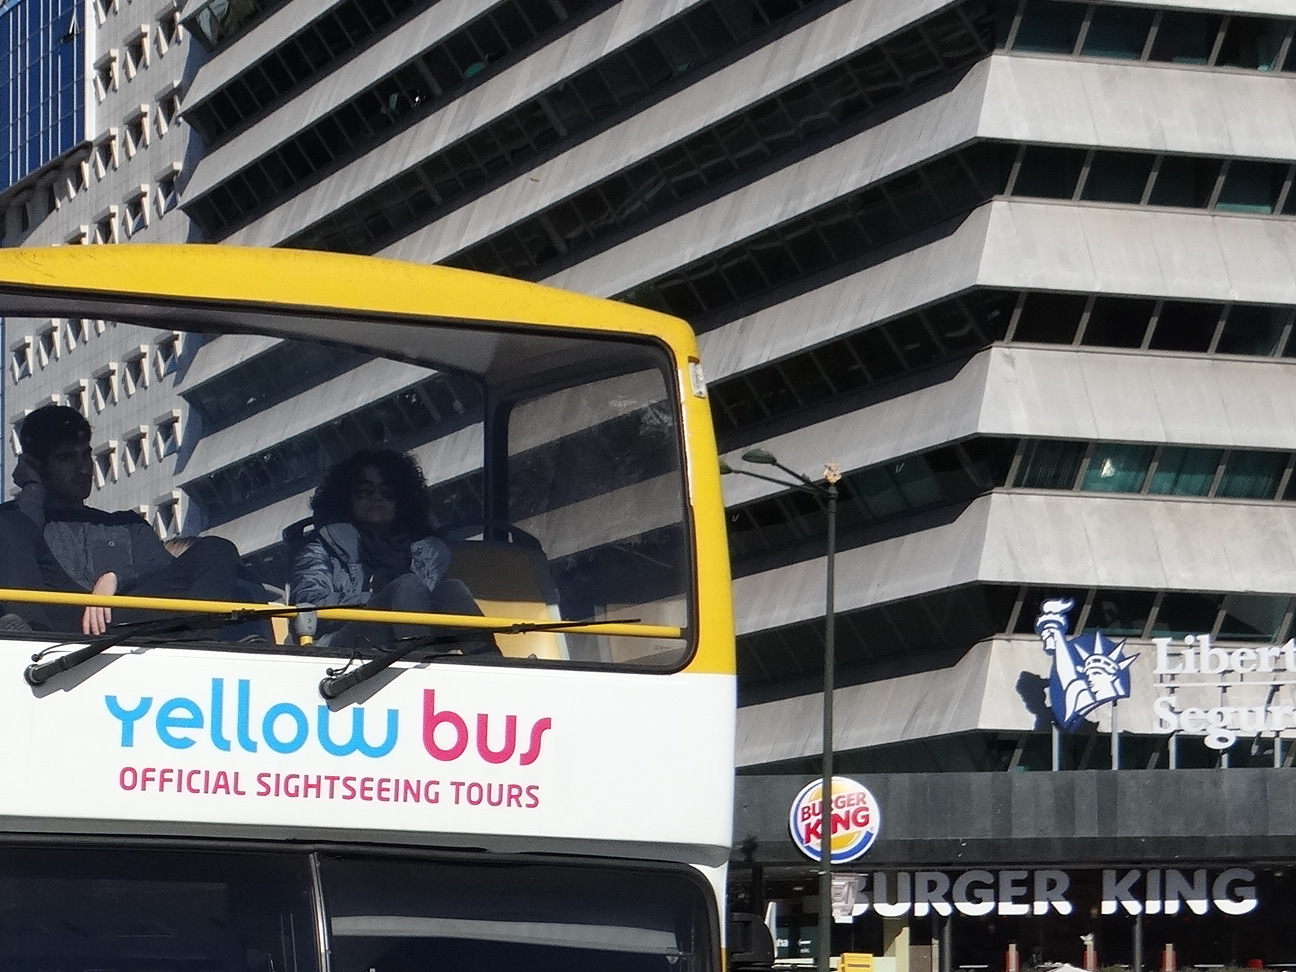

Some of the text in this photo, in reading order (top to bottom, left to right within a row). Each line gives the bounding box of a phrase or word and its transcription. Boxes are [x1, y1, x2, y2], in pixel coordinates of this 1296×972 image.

[422, 688, 552, 766] bus
[119, 766, 540, 808] OFFICIAL SIGHTSEEING TOURS
[801, 791, 867, 823] BUGER
[804, 806, 870, 845] KNG
[1100, 868, 1259, 917] KING
